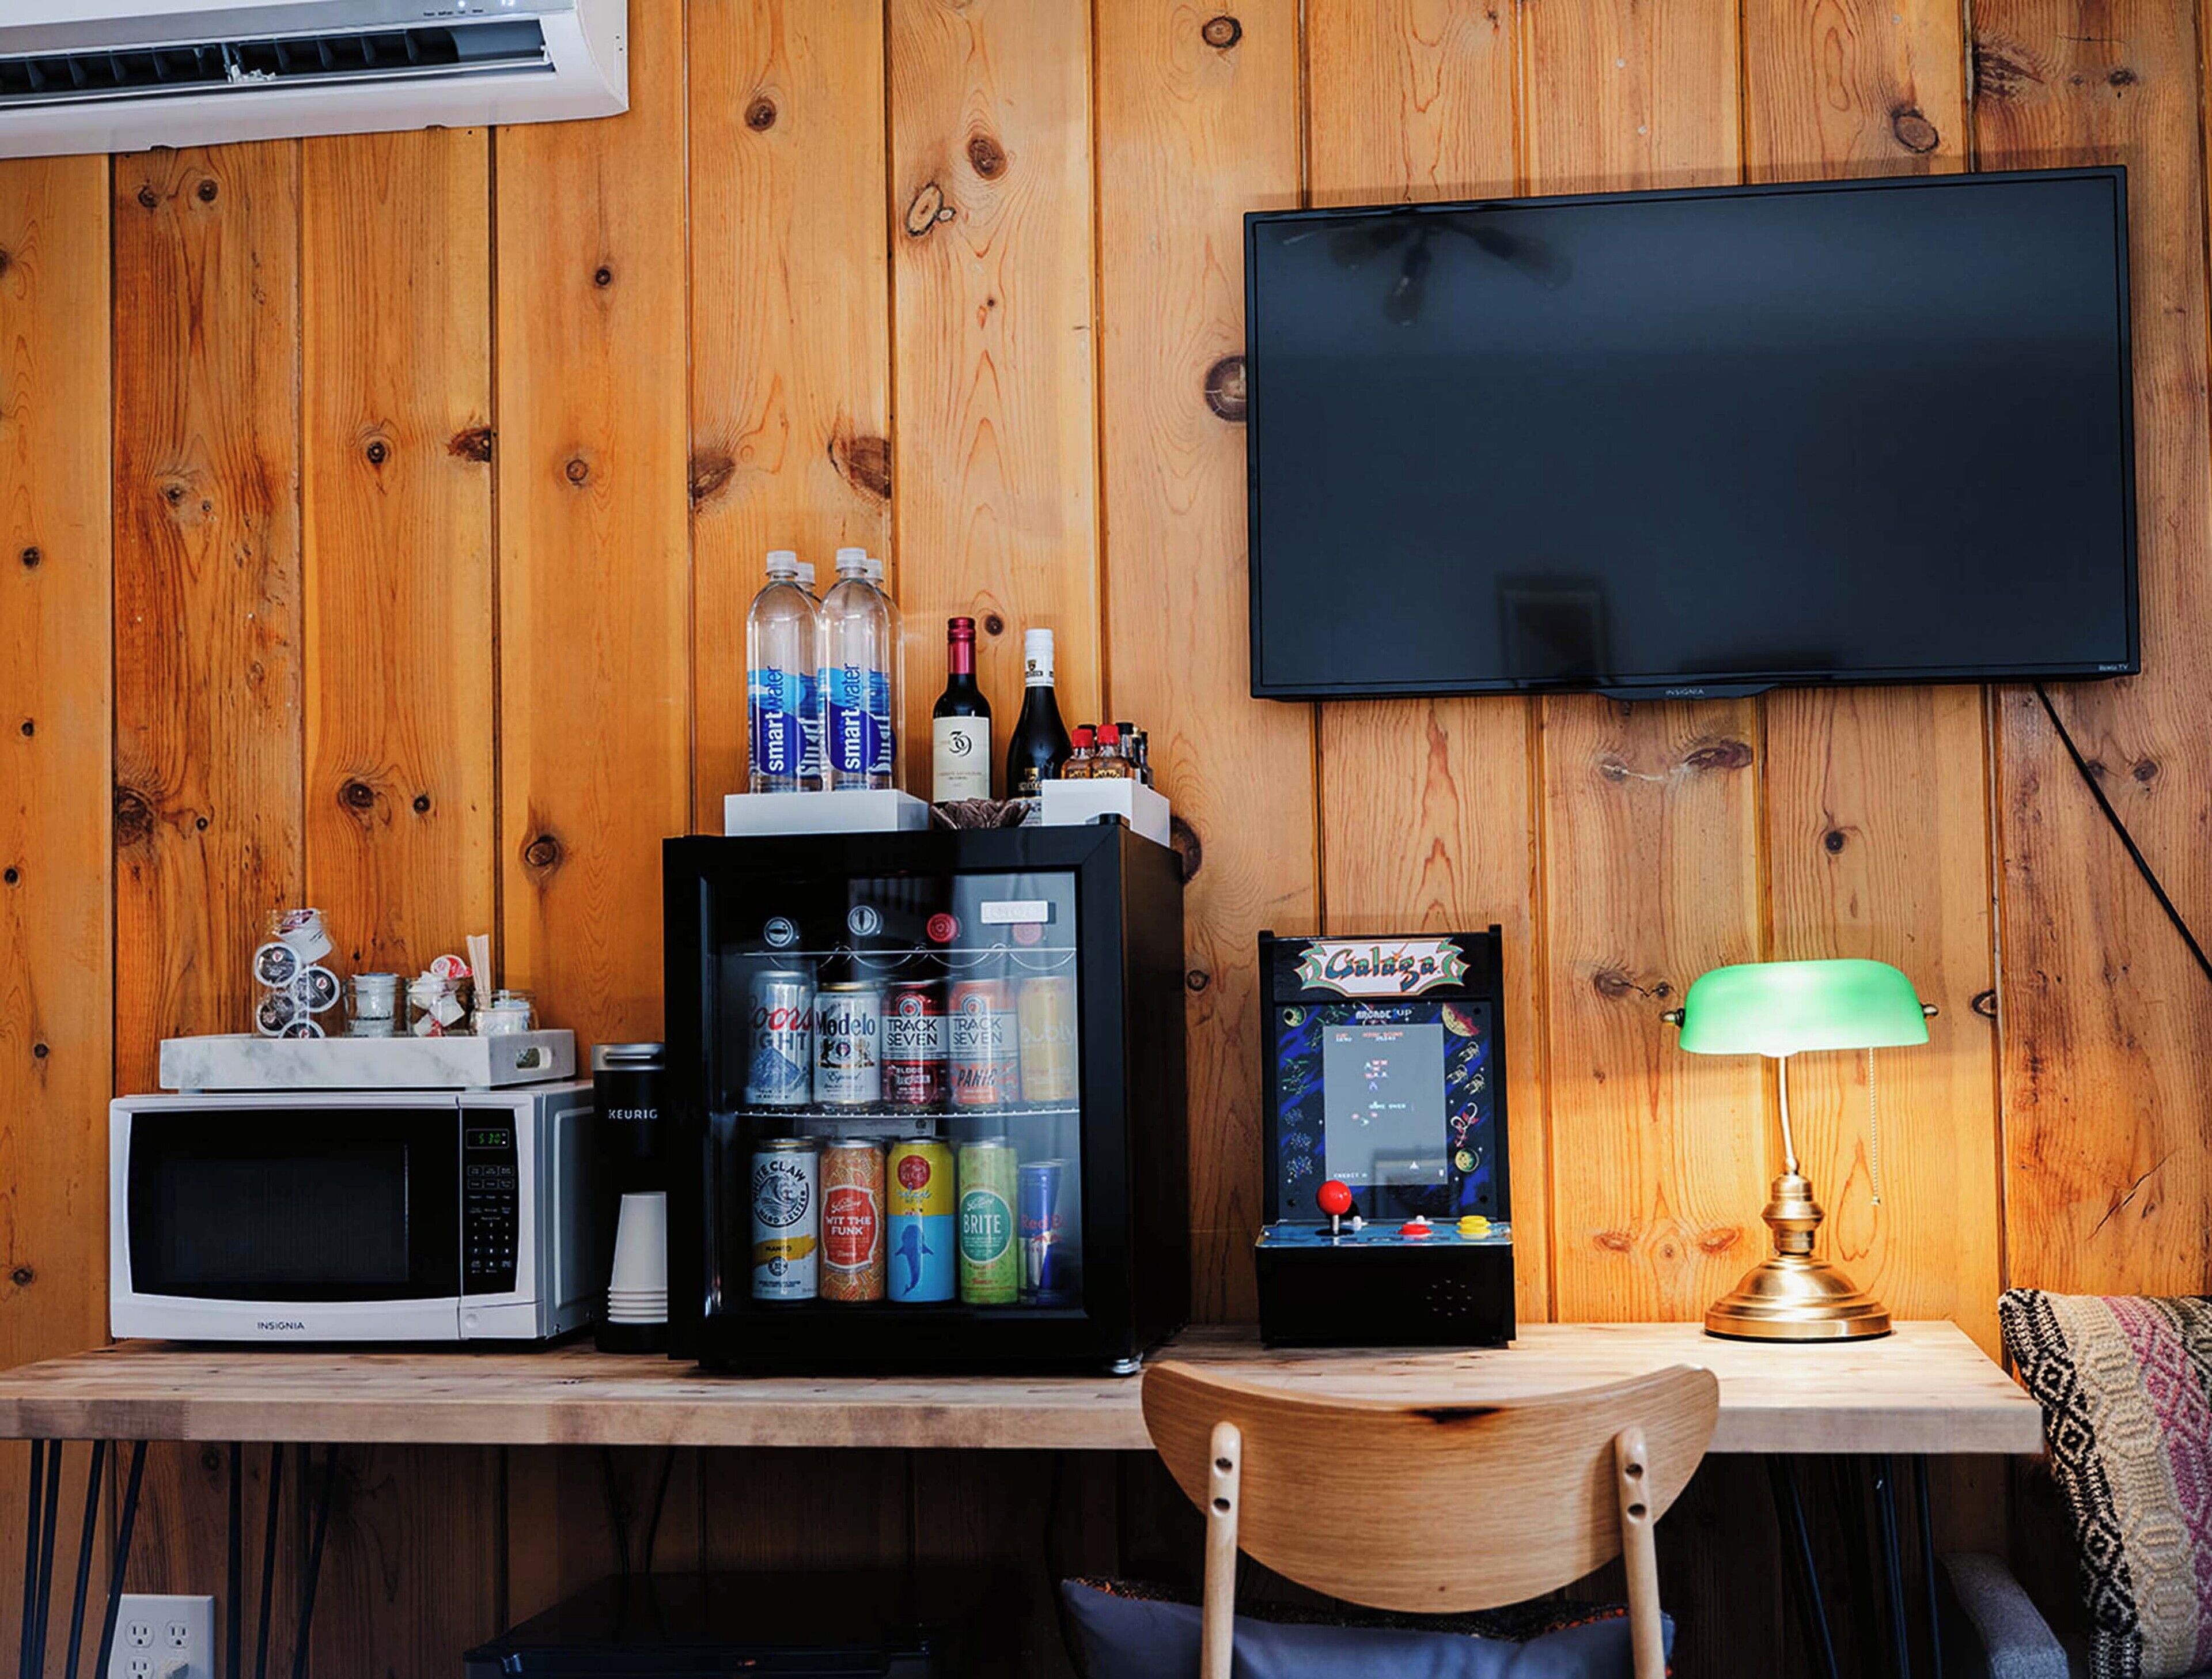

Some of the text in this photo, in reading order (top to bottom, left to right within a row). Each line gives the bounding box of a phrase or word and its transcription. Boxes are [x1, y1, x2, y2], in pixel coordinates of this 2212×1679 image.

[816, 1011, 876, 1037] Modelo
[887, 1019, 937, 1031] TRACK
[953, 1018, 1002, 1031] TRACK
[887, 1033, 937, 1046] SEVEN
[953, 1031, 1002, 1045] SEVEN
[957, 1068, 998, 1087] PANIC
[608, 1109, 657, 1119] KEURIG
[770, 1160, 806, 1182] CLAW
[825, 1216, 872, 1225] WIT THE
[964, 1213, 1001, 1234] BRITE
[1021, 1214, 1048, 1230] Red
[831, 1226, 863, 1235] FUNK
[257, 1322, 305, 1330] INSIGNIA
